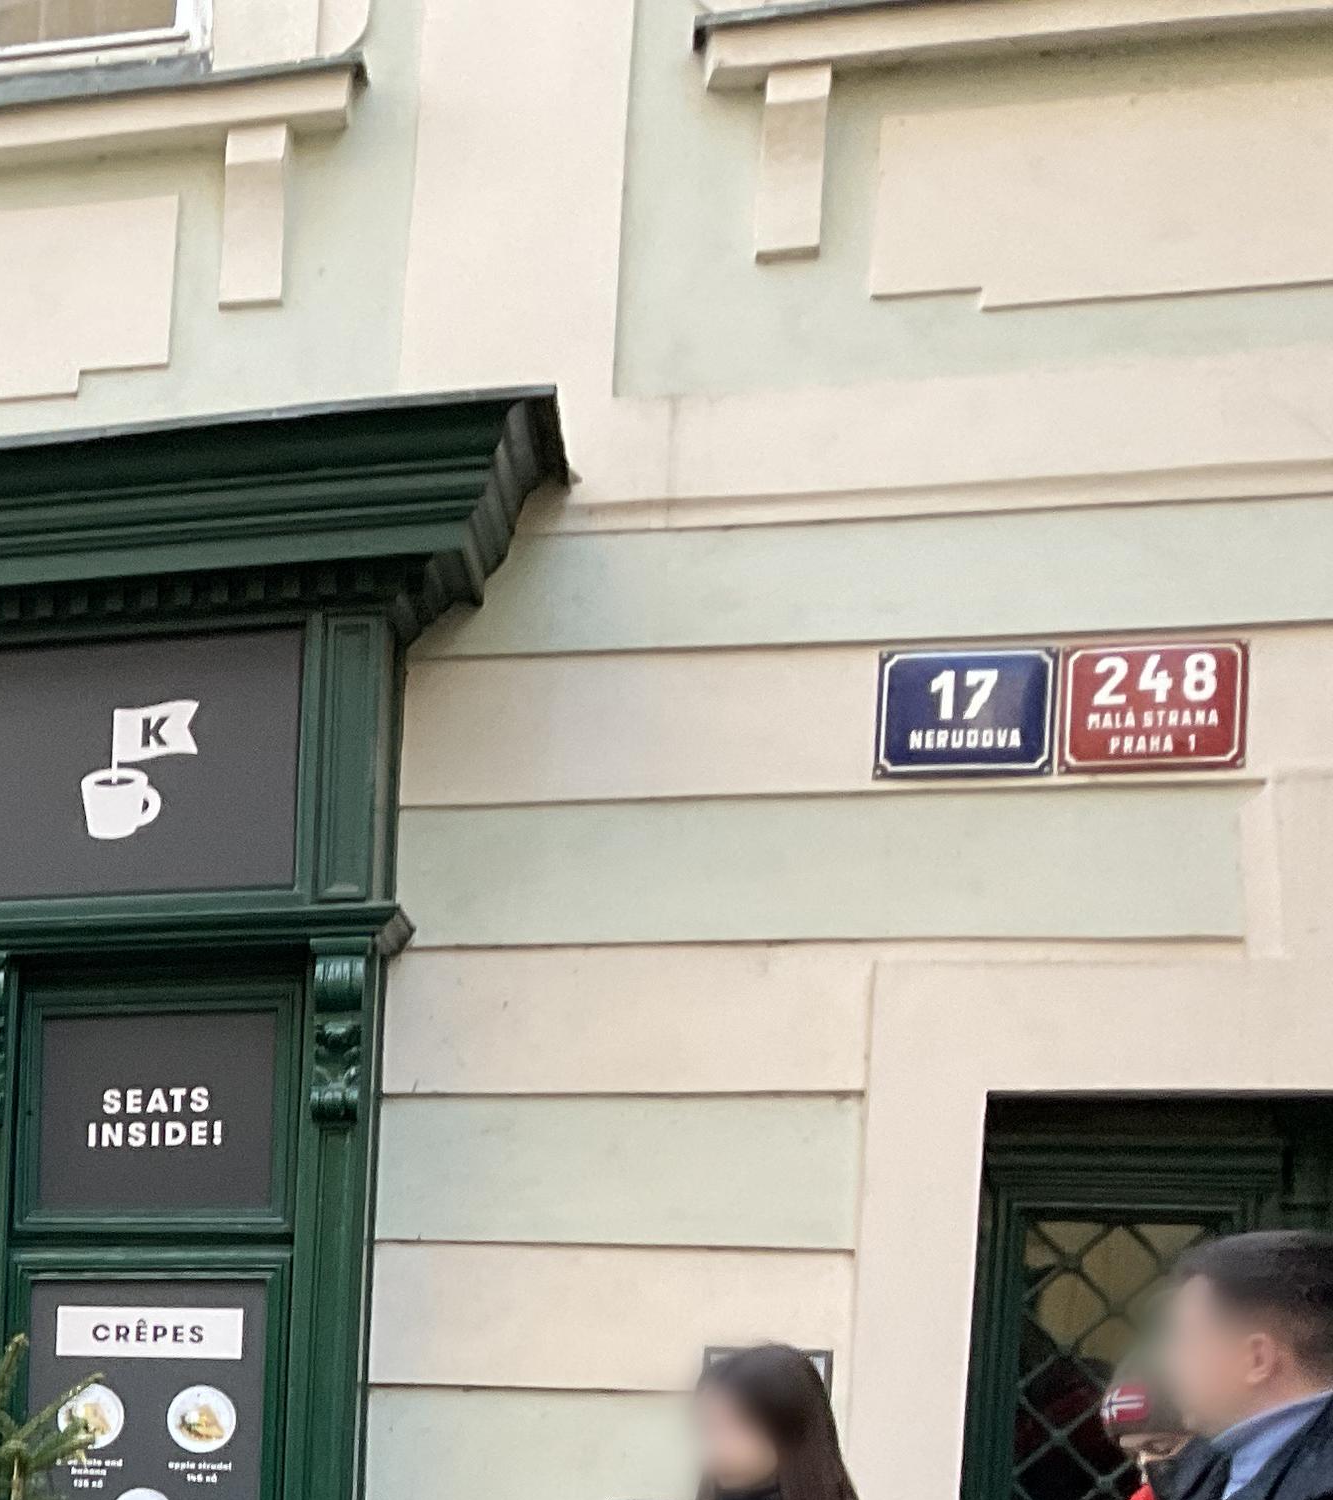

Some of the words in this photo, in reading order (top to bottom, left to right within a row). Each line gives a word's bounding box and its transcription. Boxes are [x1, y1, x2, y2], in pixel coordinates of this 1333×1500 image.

[1093, 652, 1217, 706] 248
[930, 669, 998, 720] 17
[1087, 707, 1135, 730] MALÁ
[1142, 709, 1218, 728] STRANA
[141, 716, 170, 748] K
[909, 728, 1021, 749] NERUDOVA
[1109, 734, 1173, 754] PRAHA
[1188, 734, 1196, 752] 1
[102, 1086, 209, 1114] SEATS
[87, 1120, 222, 1147] INSIDE!
[92, 1318, 204, 1343] CRÊPES
[168, 1461, 196, 1471] apple
[198, 1461, 232, 1471] strudel
